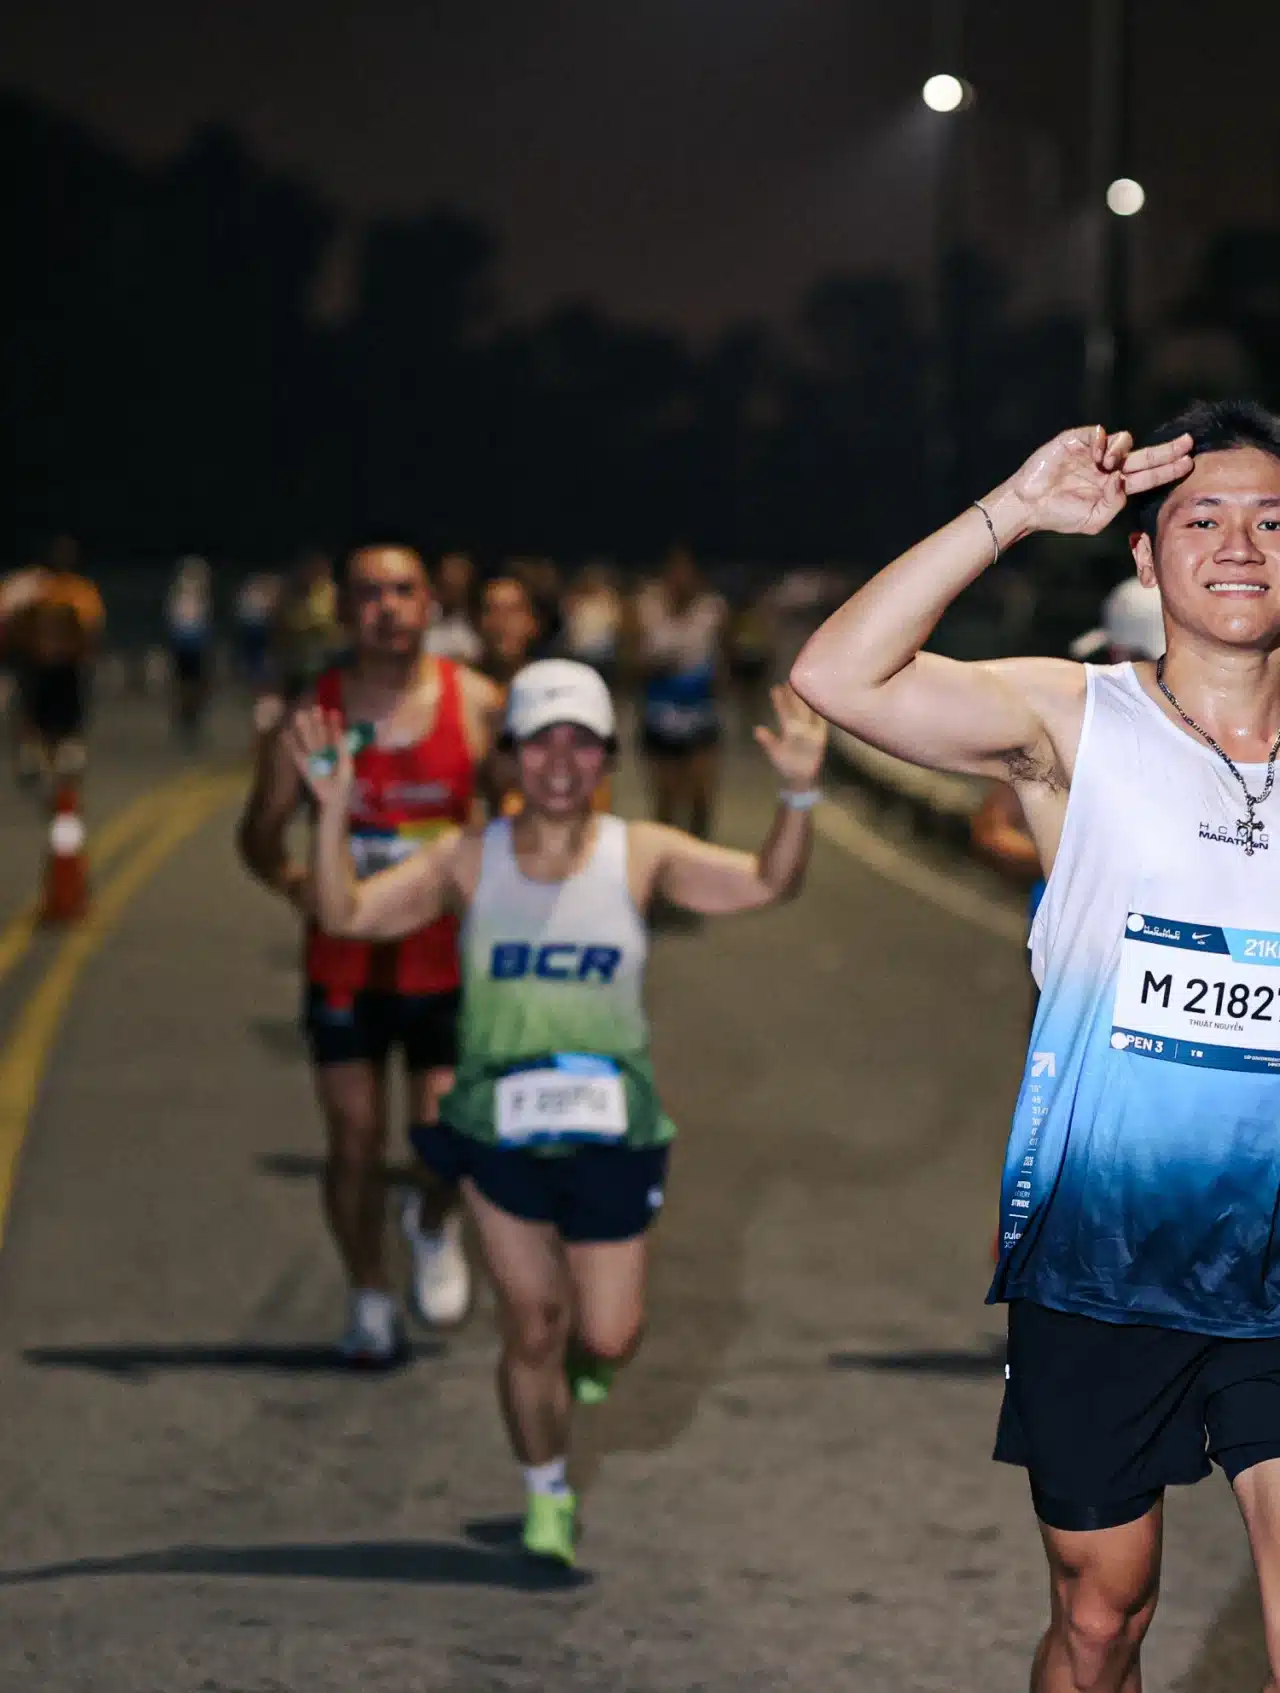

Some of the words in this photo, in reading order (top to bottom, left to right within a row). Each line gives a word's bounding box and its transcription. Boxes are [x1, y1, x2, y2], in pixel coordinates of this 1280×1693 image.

[490, 941, 623, 984] BCR
[1140, 970, 1173, 1008] M
[1154, 1041, 1164, 1053] 3
